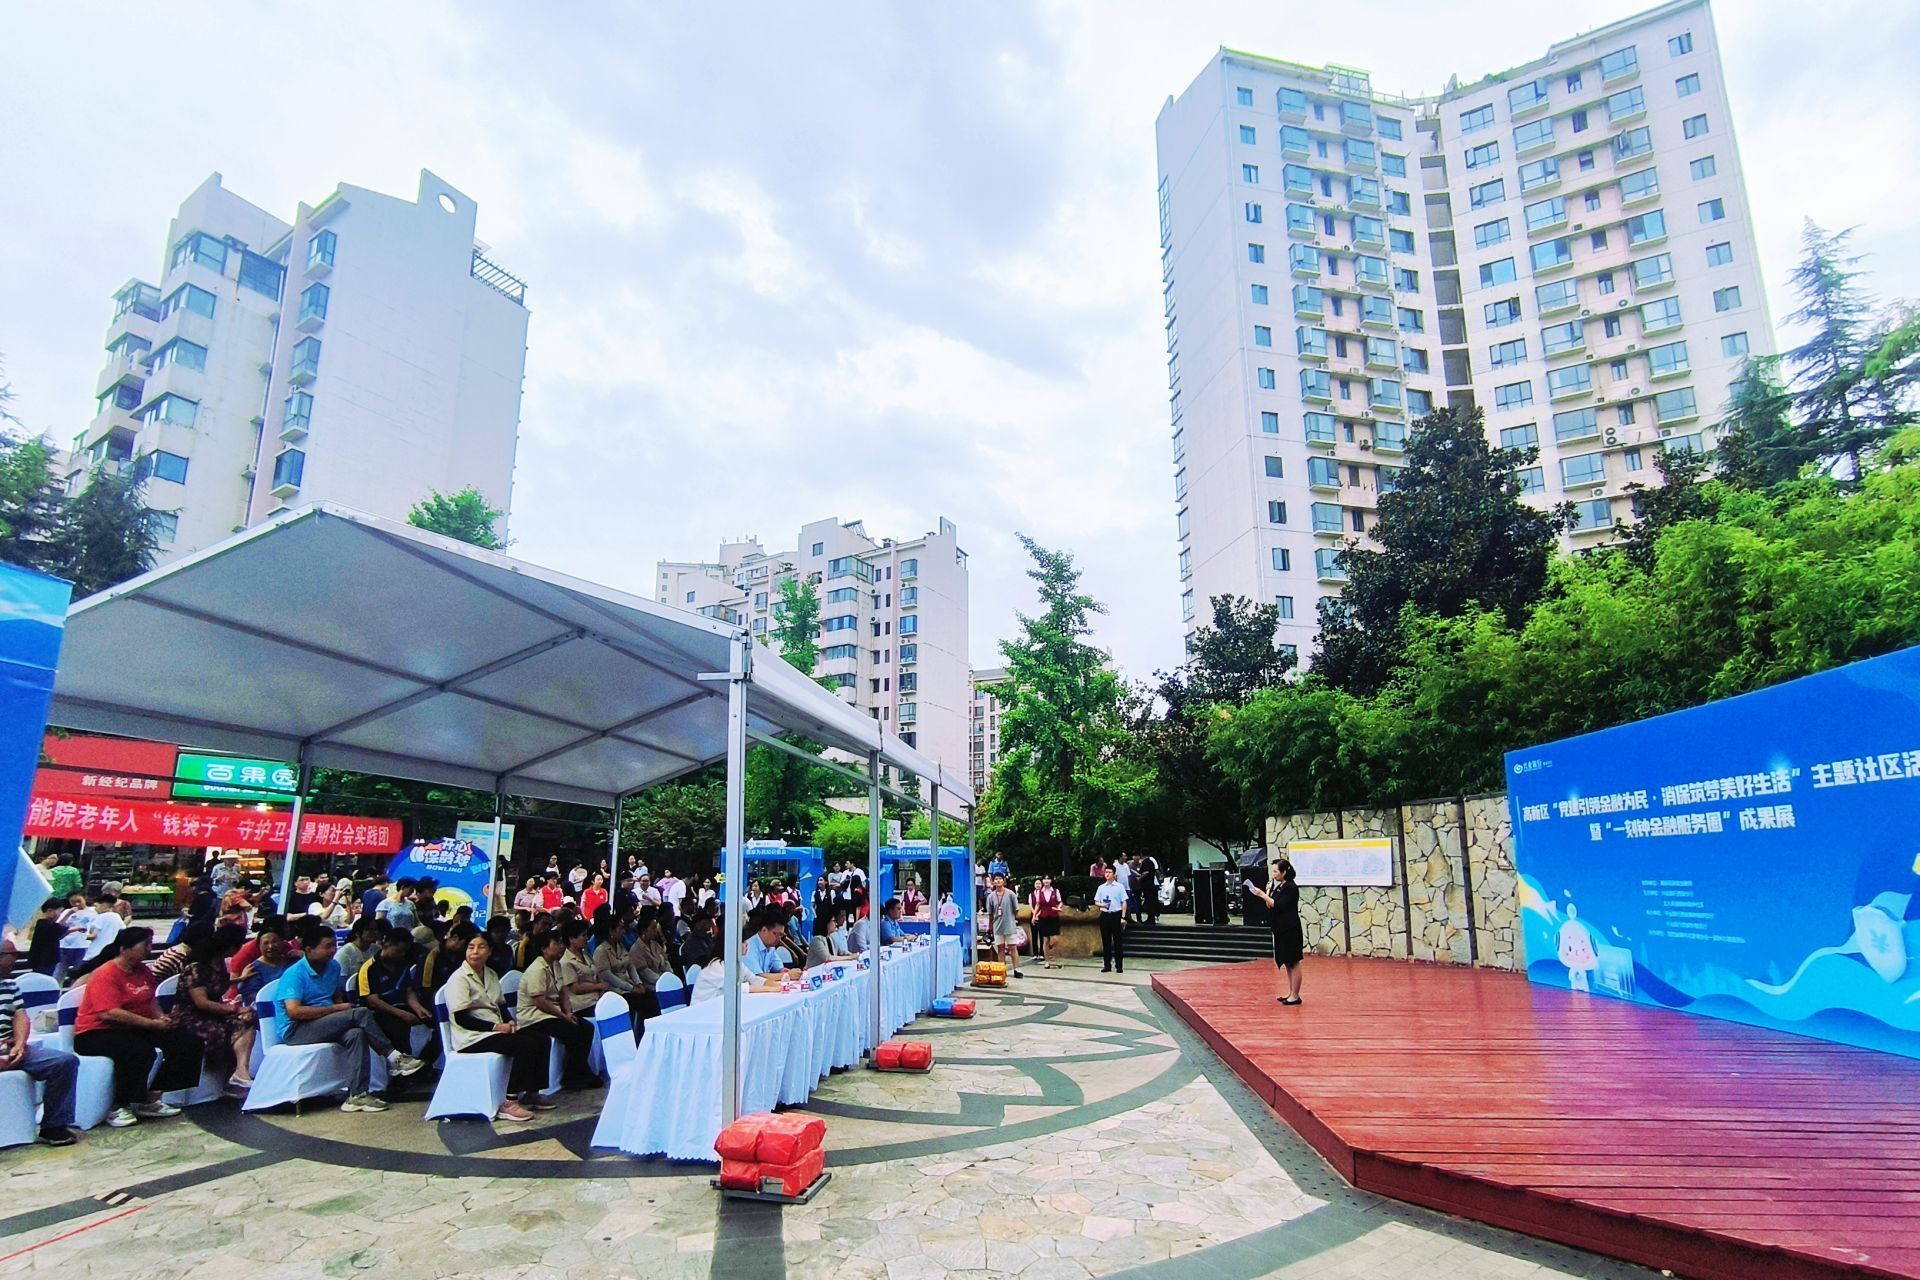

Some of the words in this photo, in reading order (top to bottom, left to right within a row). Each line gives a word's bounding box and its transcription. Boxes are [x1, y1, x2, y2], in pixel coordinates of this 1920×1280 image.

[82, 775, 158, 790] 新经纪品牌
[207, 763, 297, 786] 百果园
[28, 797, 390, 847] 能院老年人“钱袋子”守护卫暑期社会实践团
[441, 837, 469, 852] 开心
[424, 849, 472, 868] 保龄球
[425, 864, 463, 873] BOWLING
